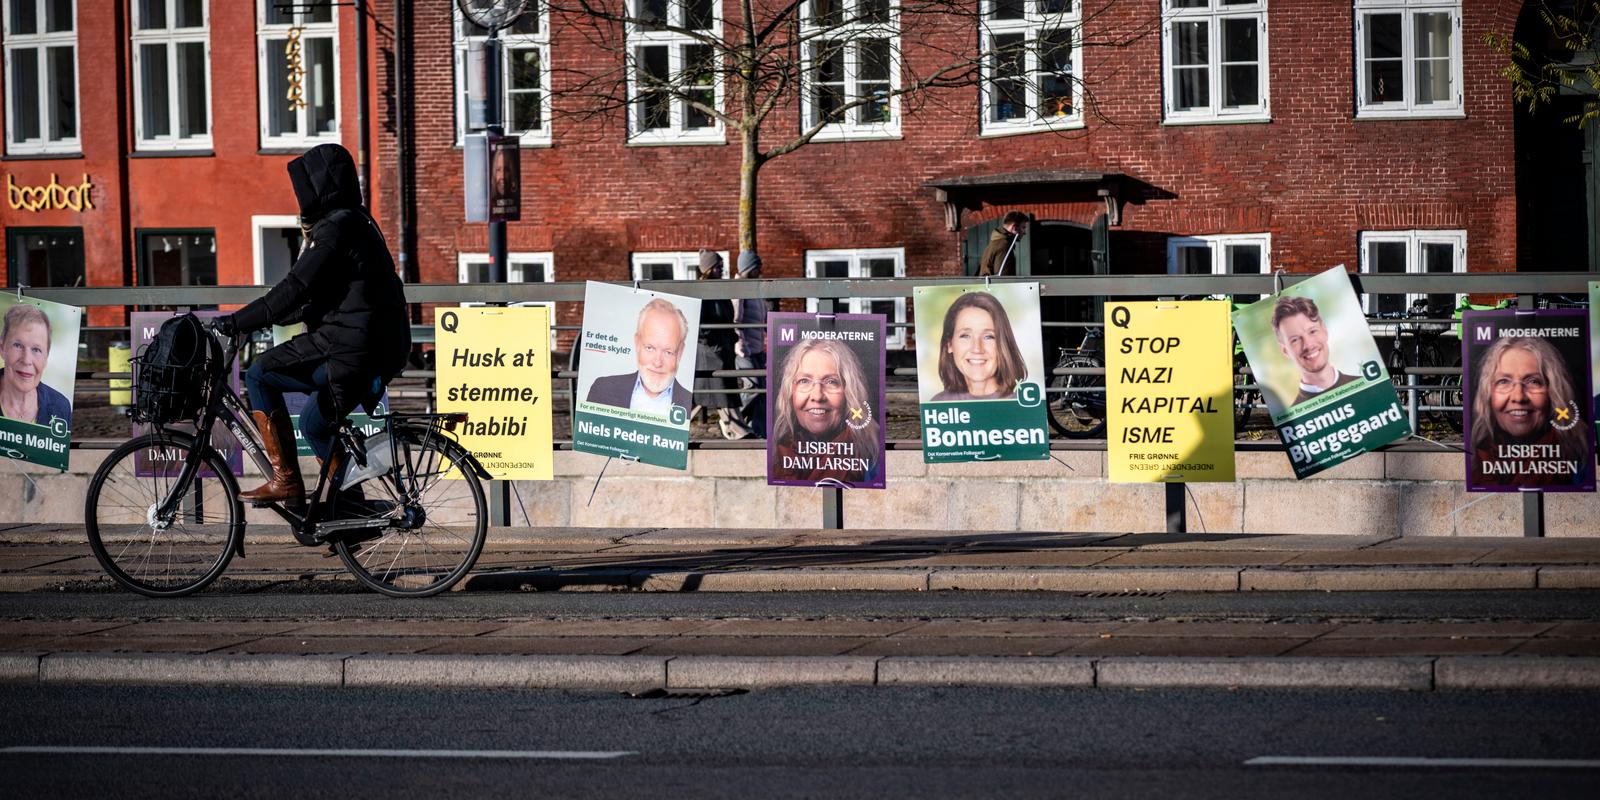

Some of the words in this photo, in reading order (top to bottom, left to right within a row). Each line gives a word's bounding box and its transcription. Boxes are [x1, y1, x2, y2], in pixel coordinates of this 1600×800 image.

[440, 311, 459, 334] Q
[1111, 305, 1131, 329] Q
[143, 327, 155, 340] M
[586, 330, 594, 338] Er
[595, 332, 608, 341] det
[781, 328, 794, 341] M
[801, 330, 875, 341] MODERATERNE
[1477, 327, 1491, 340] M
[1498, 327, 1580, 338] MODERATERNE
[585, 342, 607, 350] rødes
[607, 345, 632, 355] skyld?
[1119, 336, 1181, 354] STOP
[452, 347, 507, 367] Husk
[512, 348, 535, 367] at
[1120, 367, 1173, 384] NAZI
[1366, 364, 1378, 378] C
[447, 383, 539, 405] stemme,
[1023, 387, 1035, 402] C
[1121, 396, 1218, 414] KAPITAL
[673, 410, 682, 422] C
[924, 407, 971, 425] Helle
[1280, 402, 1356, 444] Rasmus
[54, 422, 64, 434] C
[462, 416, 528, 436] habibi
[1289, 402, 1402, 464] Bjergegaard
[231, 421, 257, 455] Gazelle
[578, 420, 610, 437] Niels
[613, 427, 651, 445] Peder
[653, 434, 685, 451] Ravn
[926, 427, 1046, 447] Bonnesen
[1122, 426, 1175, 444] ISME
[25, 433, 67, 454] Møller
[798, 441, 854, 455] LISBETH
[1498, 444, 1561, 458] LISBETH
[473, 451, 503, 459] GRØNNE
[486, 461, 535, 469] INDEPENDENT
[783, 456, 813, 470] DAM
[816, 457, 869, 471] LARSEN
[1129, 463, 1159, 471] GREENS
[1161, 463, 1215, 471] INDEPENDENT
[1482, 460, 1516, 474] DAM
[1518, 460, 1578, 474] LARSEN
